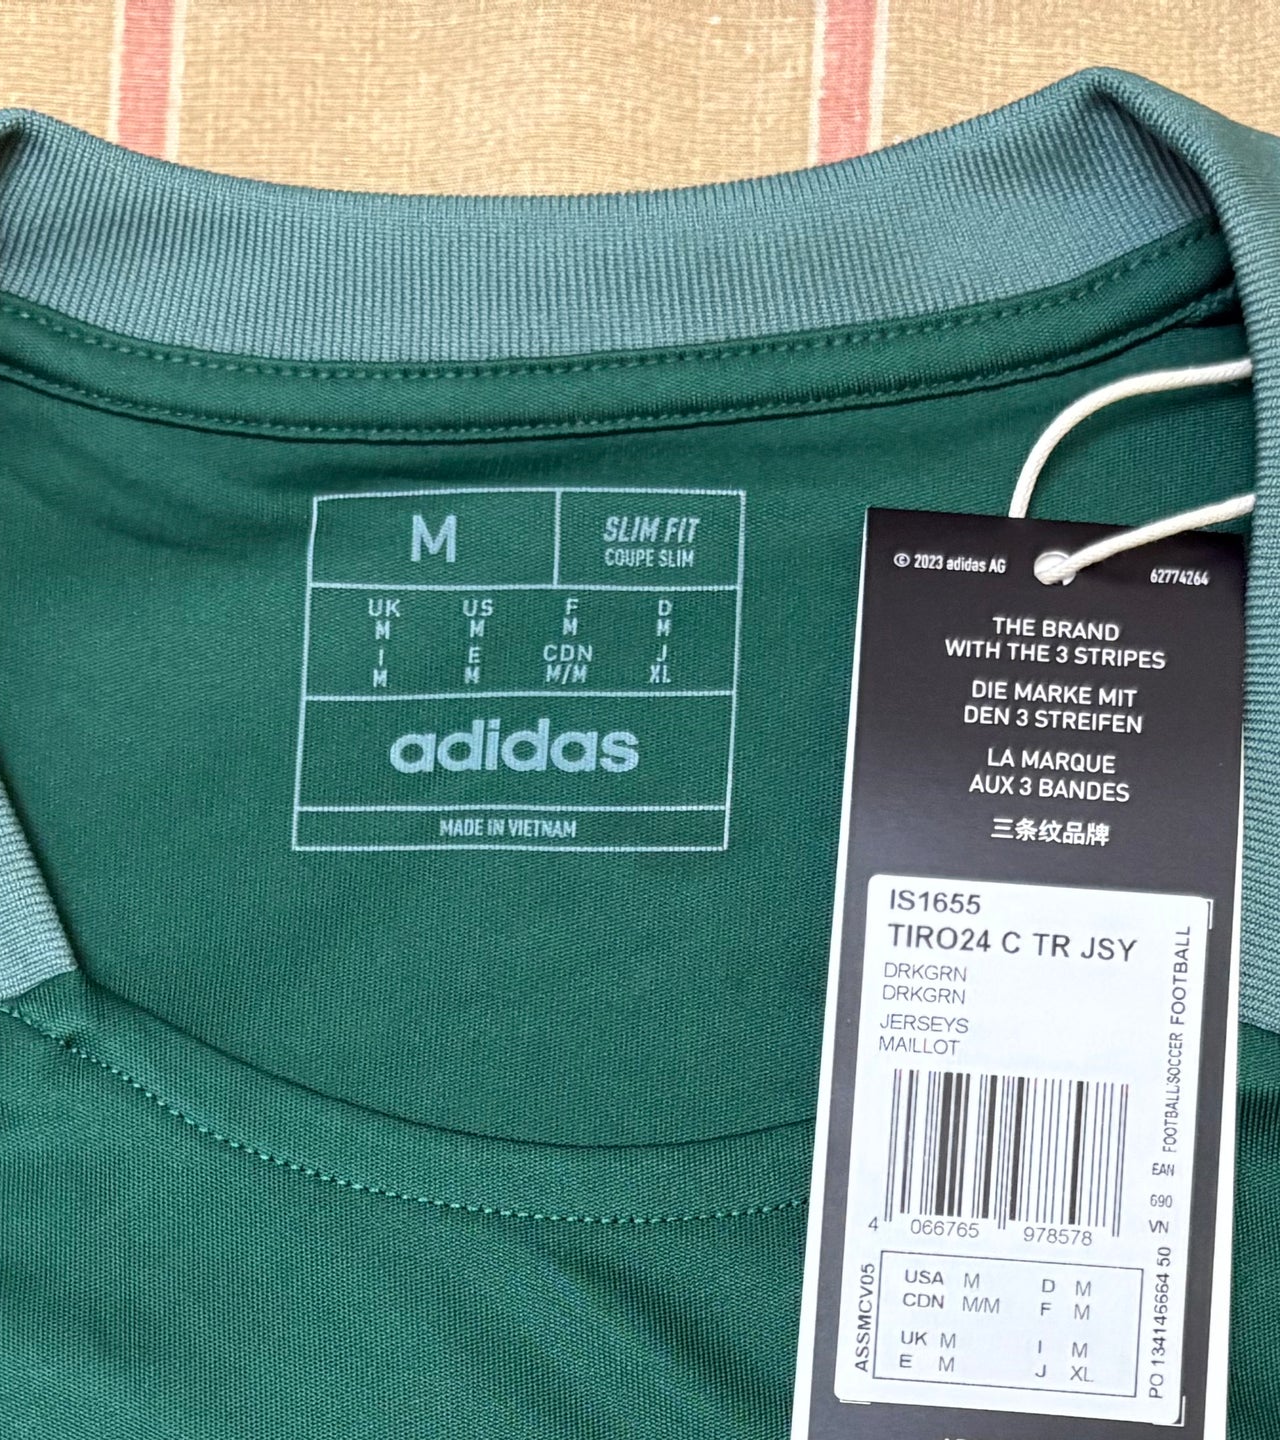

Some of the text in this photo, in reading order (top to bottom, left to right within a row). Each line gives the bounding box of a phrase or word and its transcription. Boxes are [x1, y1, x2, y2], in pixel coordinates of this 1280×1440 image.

[410, 515, 457, 563] M
[603, 516, 700, 543] SLIM FIT
[604, 549, 694, 568] COUPE SLIM
[914, 554, 943, 570] 2023
[946, 556, 986, 573] adidas
[988, 558, 1006, 574] AG
[1150, 568, 1209, 586] 62774264
[368, 599, 672, 617] UK US F D
[376, 618, 671, 640] M M M M
[992, 616, 1119, 641] THE BRAND
[379, 645, 667, 666] I E CDN J
[944, 639, 1166, 670] WITH THE 3 STRIPES
[373, 665, 671, 688] M M M/M XL
[971, 680, 1137, 707] DIE MARKE MIT
[963, 705, 1142, 734] DEN 3 STREIFEN
[389, 718, 639, 774] adidas
[987, 748, 1116, 774] LA MARQUE
[969, 774, 1130, 803] AUX 3 BANDES
[440, 819, 576, 838] MADE IN VIETNAM
[990, 817, 1110, 847] 三条纹品牌
[889, 888, 981, 915] IS1655
[887, 923, 1138, 963] TIRO24 C TR JSY
[884, 962, 967, 982] DRKGRN
[1170, 925, 1191, 1026] FOOTBALL
[882, 984, 966, 1005] DRKGRN
[880, 1013, 969, 1034] JERSEYS
[878, 1035, 960, 1056] MAILLOT
[1151, 1163, 1175, 1176] EAN
[1150, 1195, 1173, 1208] 690
[868, 1217, 1093, 1247] 4 066765 978578
[1148, 1220, 1170, 1234] VN
[904, 1269, 1092, 1297] USA M D M
[855, 1263, 875, 1373] ASSMCV05
[903, 1293, 1090, 1321] CDN M/M F M
[1148, 1245, 1171, 1399] PO 134146664 50
[900, 1331, 927, 1347] UK
[940, 1332, 956, 1349] M
[1072, 1342, 1088, 1358] M
[899, 1354, 1094, 1383] E M J XL
